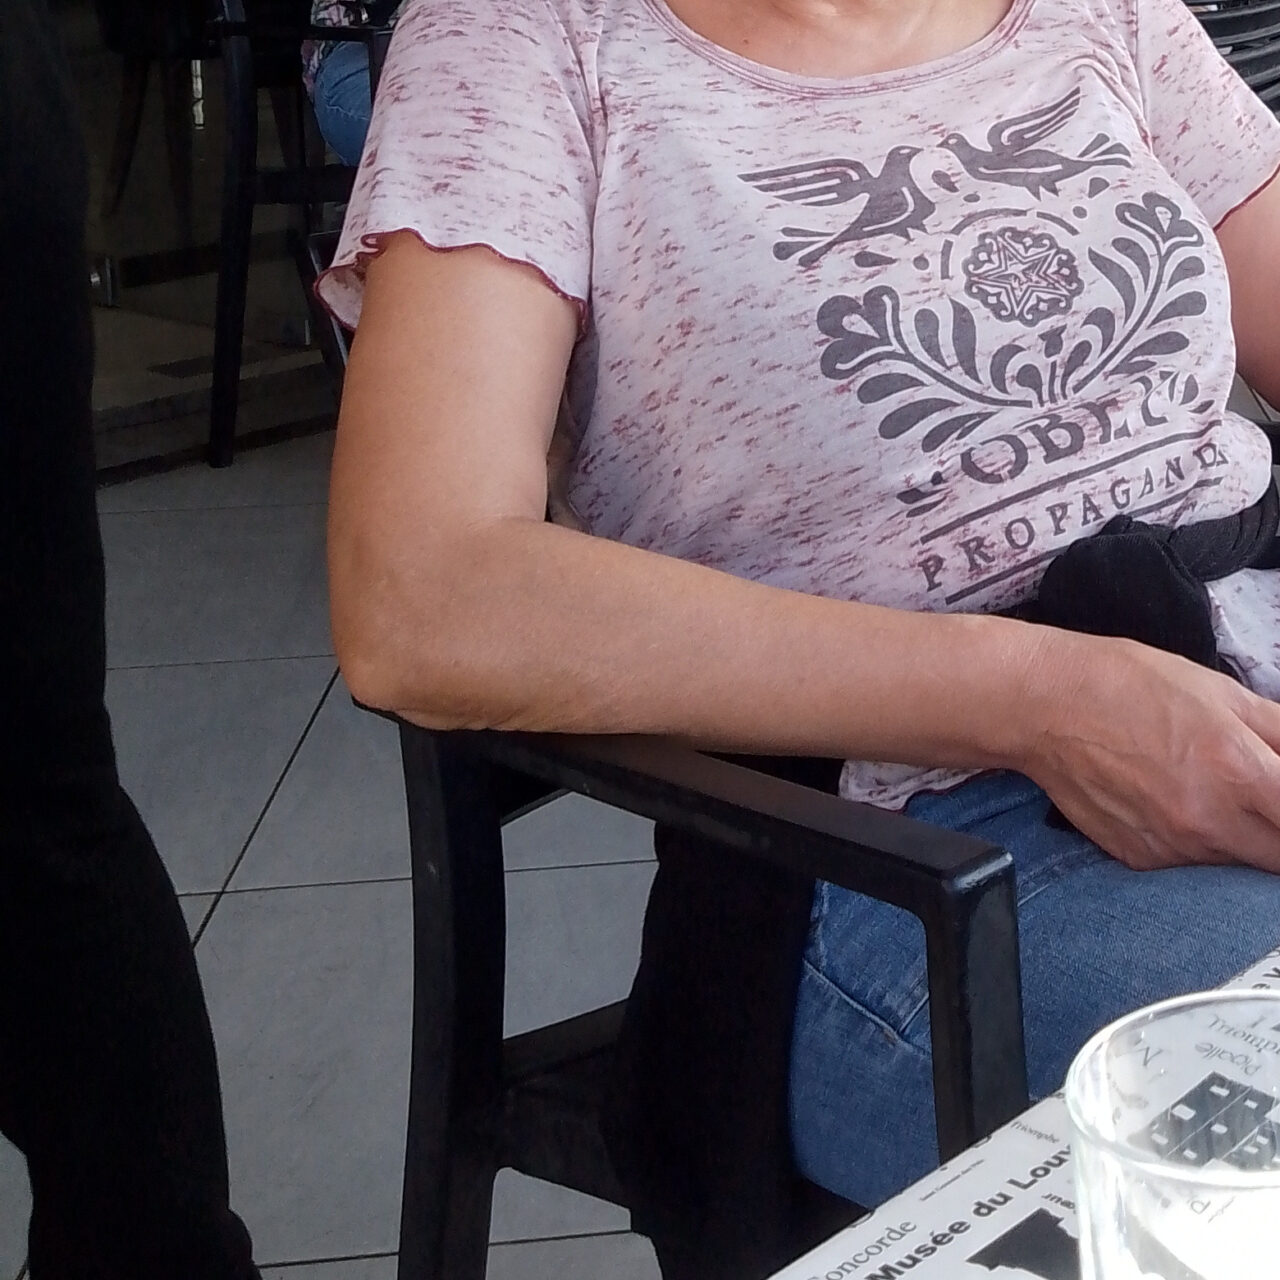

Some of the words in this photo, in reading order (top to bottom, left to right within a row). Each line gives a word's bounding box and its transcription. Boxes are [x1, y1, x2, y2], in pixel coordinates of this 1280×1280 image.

[866, 1220, 972, 1280] Musée
[972, 1187, 1014, 1218] du
[1006, 1143, 1071, 1191] Louv
